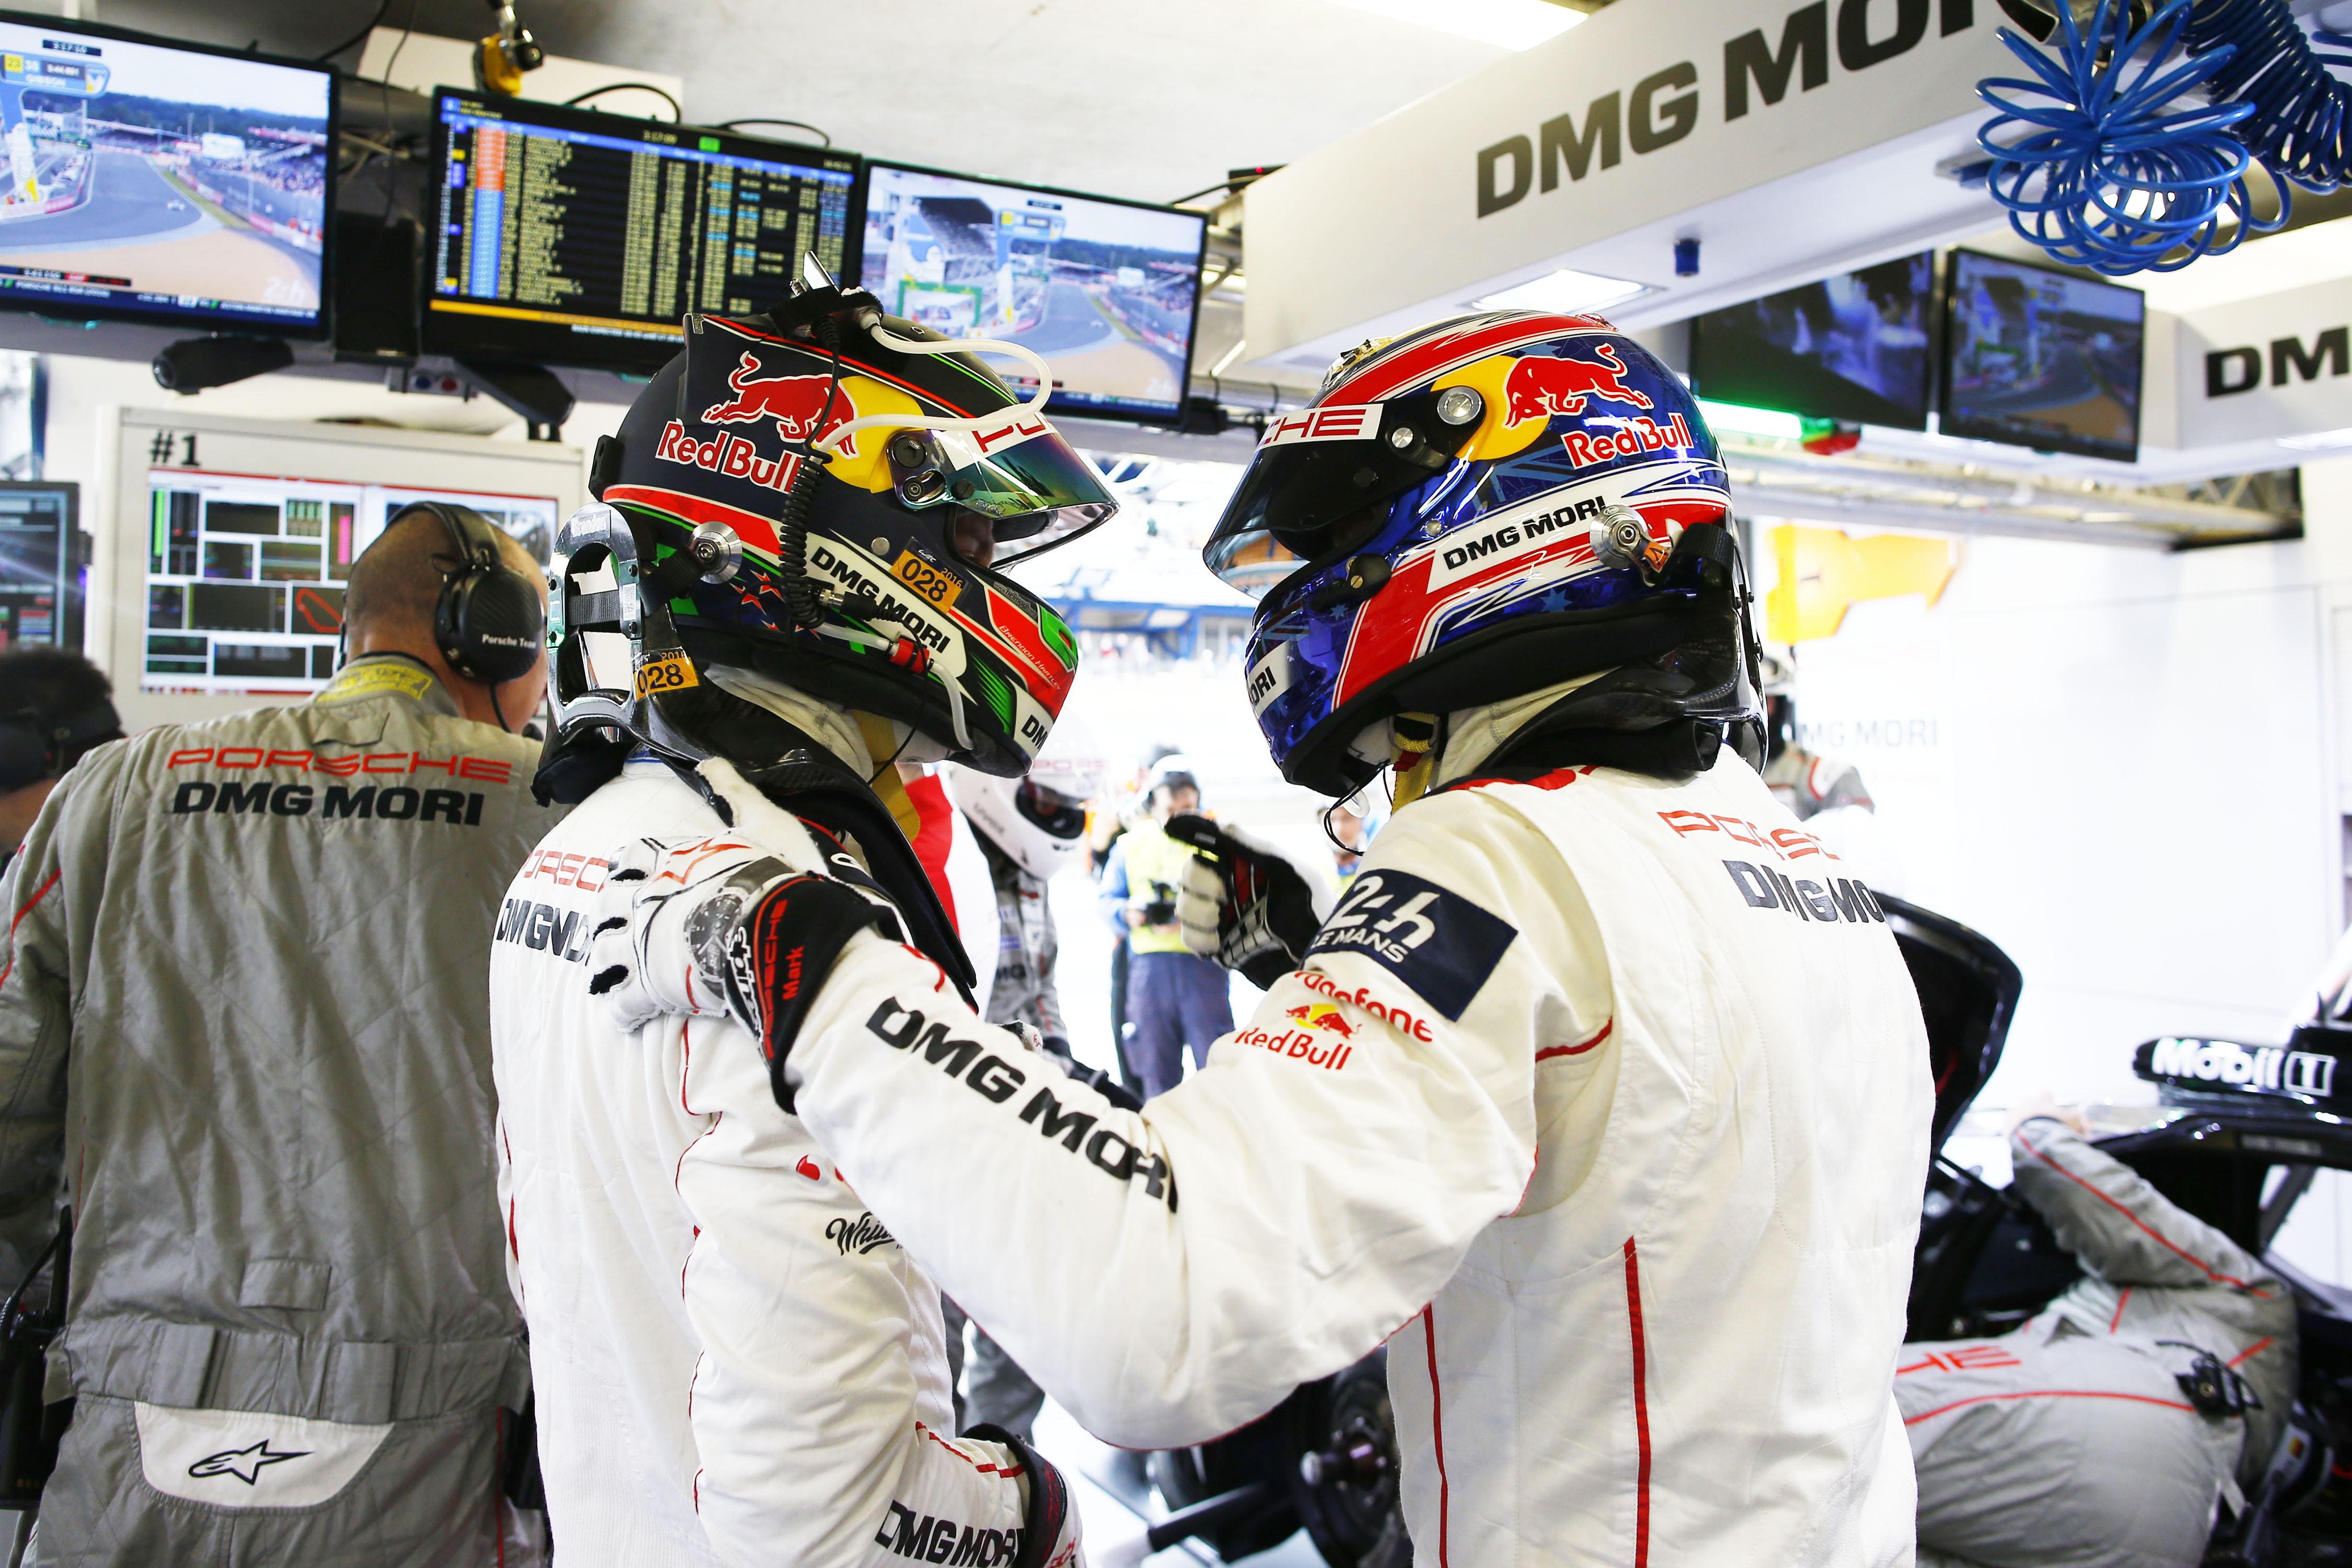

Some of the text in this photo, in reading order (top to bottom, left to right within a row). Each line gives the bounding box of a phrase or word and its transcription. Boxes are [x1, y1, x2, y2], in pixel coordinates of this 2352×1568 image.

[1477, 60, 1699, 220] DMG
[2206, 325, 2350, 398] DM
[150, 431, 200, 466] #1
[655, 420, 805, 494] Red Bull
[1561, 412, 1694, 470] Red Bull
[1443, 496, 1606, 570] DMG MORI
[810, 547, 950, 654] DMG MORI
[902, 559, 963, 602] 028 2016
[482, 634, 537, 649] Porsche Team
[637, 663, 684, 694] 028
[1856, 718, 1938, 747] MORI
[168, 747, 511, 784] PORSCHE
[172, 782, 484, 826] DMG MORI
[1721, 859, 1838, 922] DMG
[496, 899, 554, 953] DMG
[1332, 928, 1409, 963] MANS
[782, 946, 805, 1000] Mark
[866, 996, 1026, 1104] DMG
[1234, 1027, 1352, 1070] Red Bull
[2151, 1036, 2285, 1091] Mobil
[874, 1499, 956, 1564] DMG
